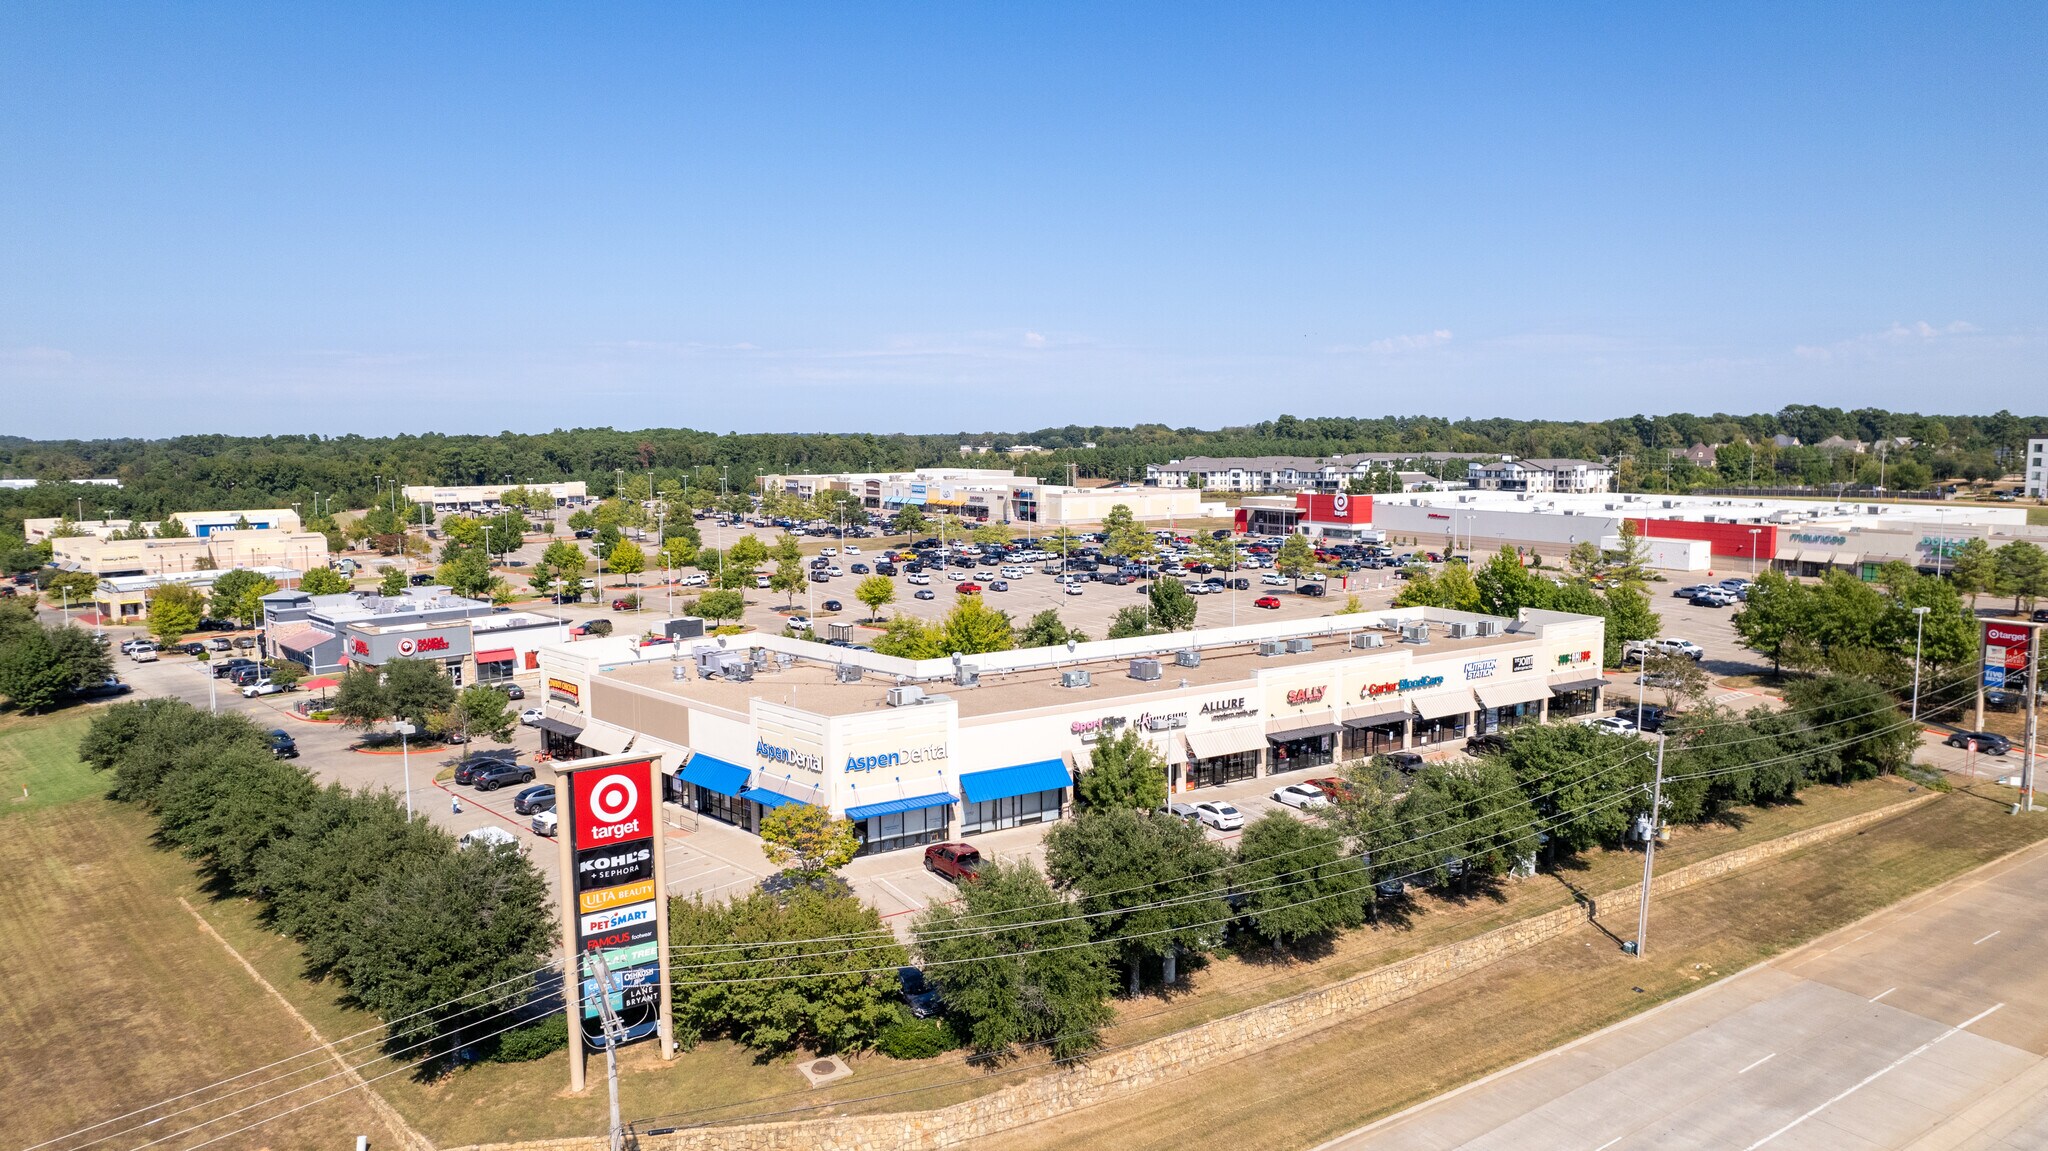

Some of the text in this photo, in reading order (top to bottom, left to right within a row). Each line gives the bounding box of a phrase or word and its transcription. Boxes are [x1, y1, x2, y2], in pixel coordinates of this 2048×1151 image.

[1789, 533, 1846, 545] maurices
[418, 636, 444, 645] PANDA
[1999, 631, 2026, 641] target
[1464, 659, 1497, 672] NUTRITION
[1466, 669, 1494, 680] STATION
[1369, 676, 1444, 695] Carter BloodCare
[1288, 685, 1327, 702] SALLY
[1200, 697, 1245, 714] ALLURE
[591, 819, 640, 840] target
[580, 849, 650, 873] KOHL'S
[599, 865, 640, 878] SEPHORA
[588, 885, 653, 906] ULTA BEAUTY
[587, 931, 652, 950] FAMOUS footwear
[631, 947, 657, 960] TREE
[631, 986, 653, 998] LANE
[626, 993, 658, 1007] BRYANT
